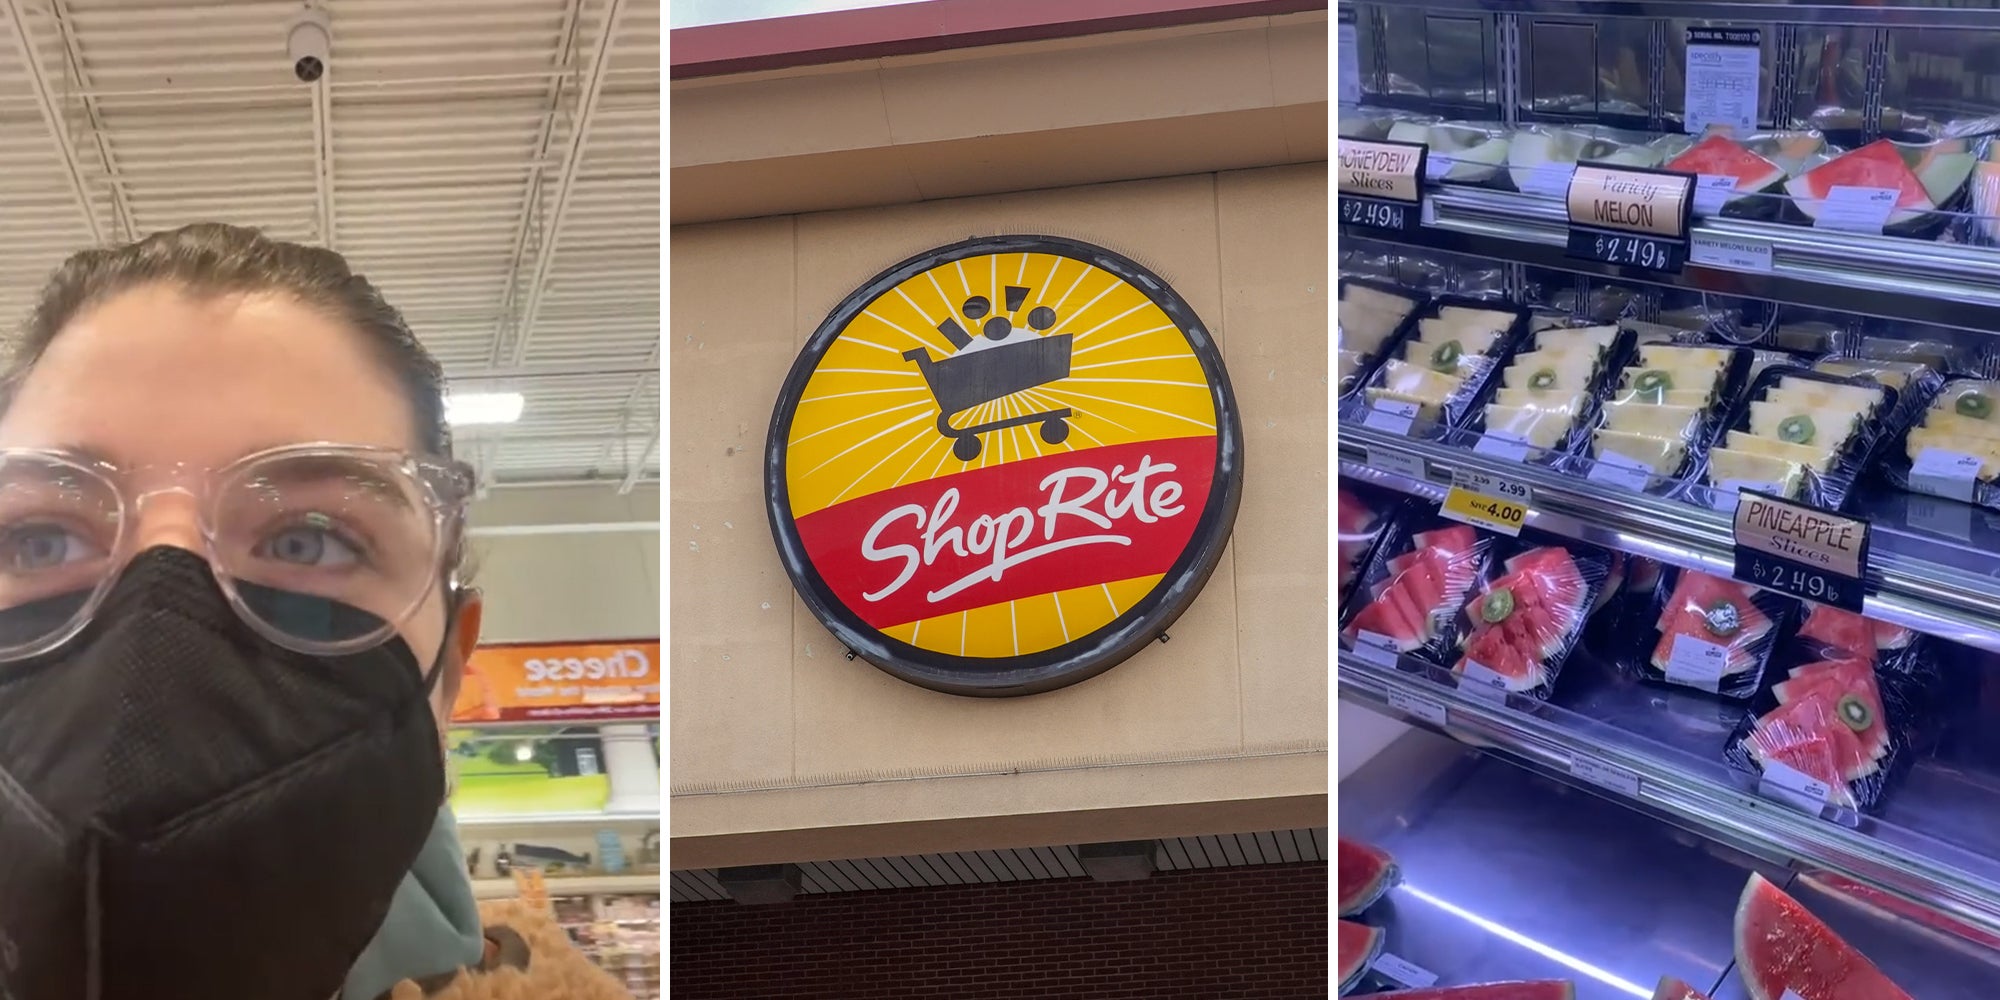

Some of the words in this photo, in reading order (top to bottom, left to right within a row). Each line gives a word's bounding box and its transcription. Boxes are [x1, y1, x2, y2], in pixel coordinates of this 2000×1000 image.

[1350, 170, 1394, 191] Slices
[1602, 175, 1658, 202] Variety
[1343, 200, 1391, 227] $2.49
[1593, 199, 1653, 227] MELON
[1595, 236, 1655, 267] $2.49
[1499, 481, 1526, 497] 2.99
[1487, 503, 1522, 522] 4.00
[1746, 501, 1852, 551] PINEAPPLE
[861, 455, 1185, 602] ShopRite
[1769, 535, 1831, 564] Slices
[1753, 558, 1825, 597] $2.49
